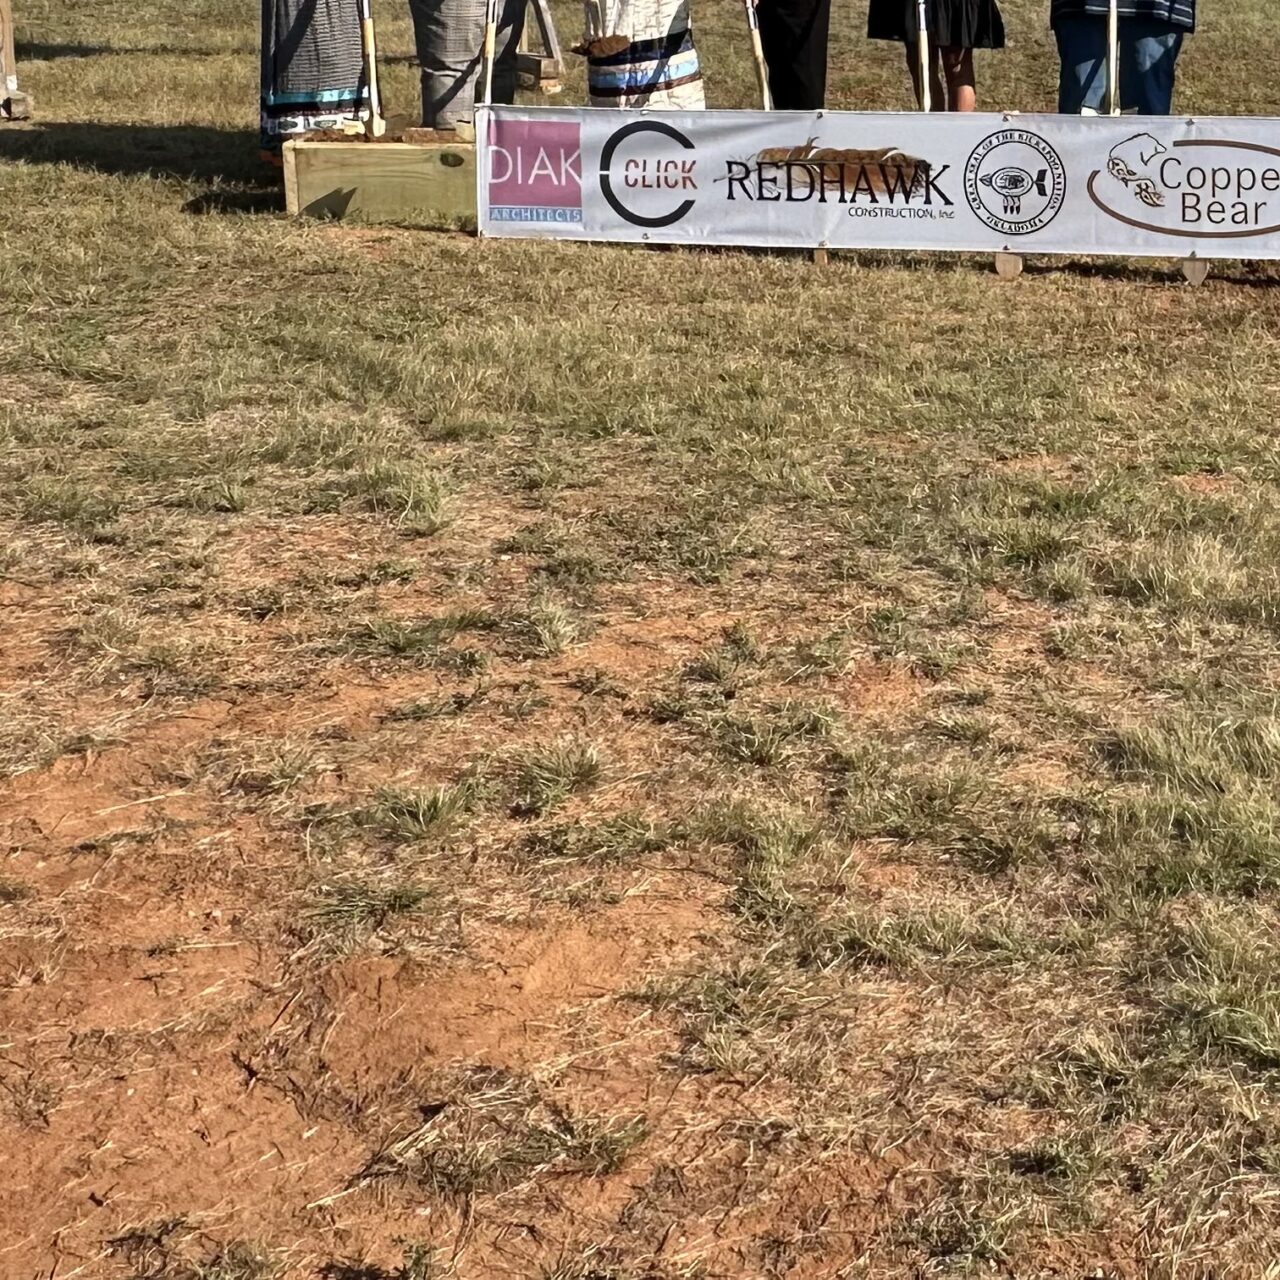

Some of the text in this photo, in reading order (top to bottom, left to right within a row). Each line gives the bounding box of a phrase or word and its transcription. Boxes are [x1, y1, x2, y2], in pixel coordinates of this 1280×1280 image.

[995, 132, 1016, 144] THE
[488, 145, 582, 187] DIAK
[624, 158, 698, 190] CLICK
[726, 160, 955, 206] REDHAWK
[490, 208, 581, 222] ARCHITECTS
[848, 206, 937, 220] CONSTRUCTION,
[1181, 192, 1267, 225] Bear
